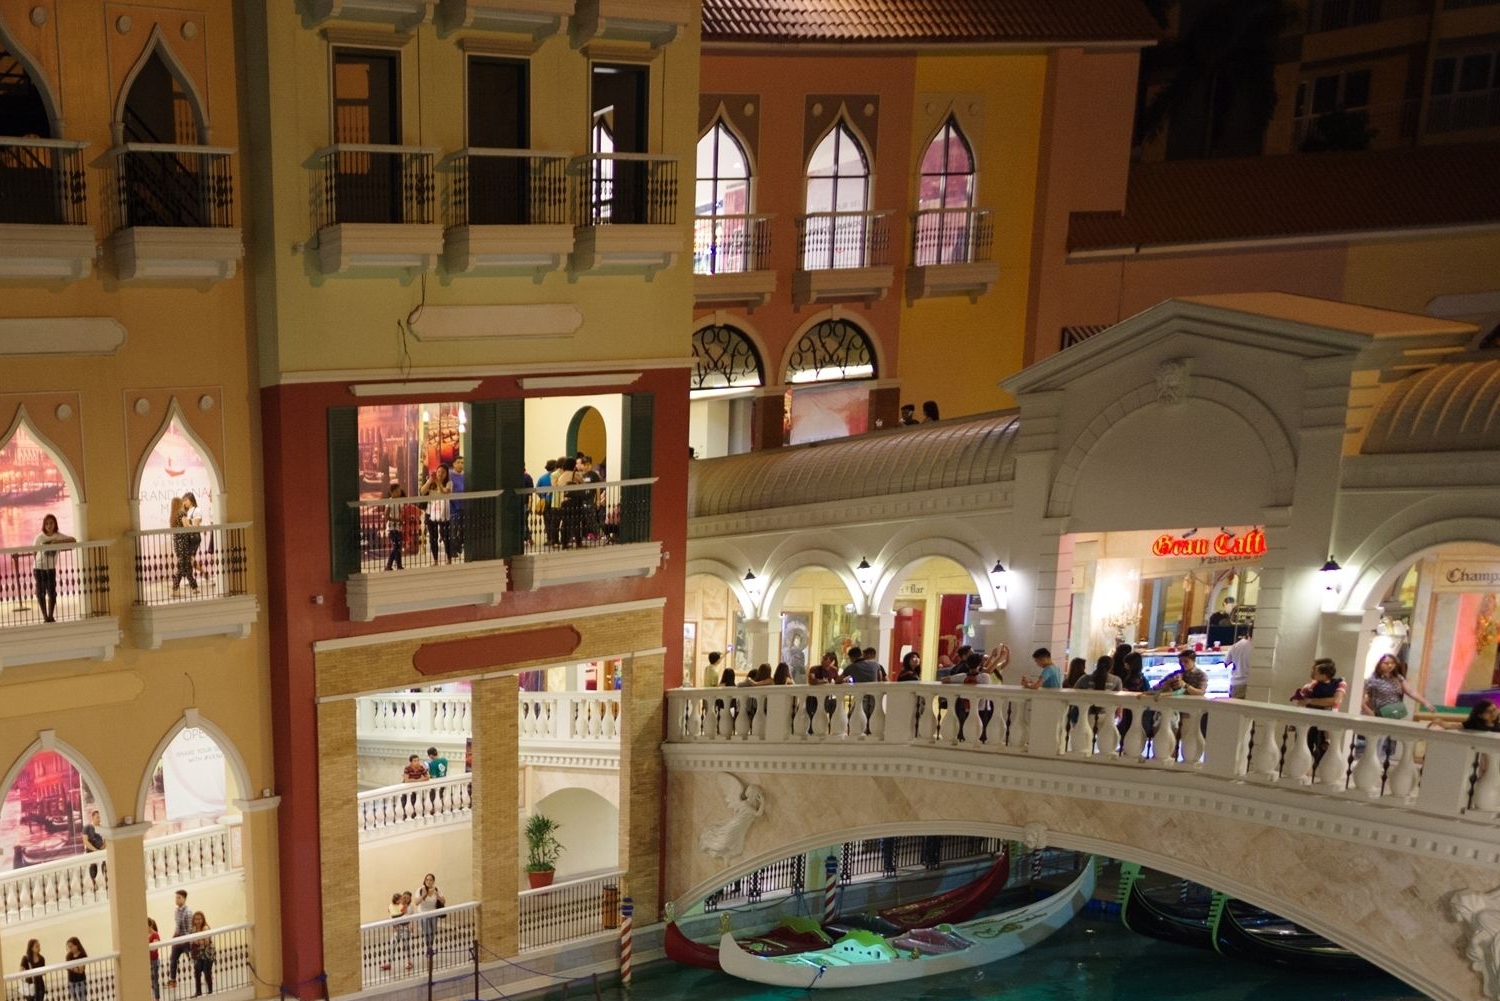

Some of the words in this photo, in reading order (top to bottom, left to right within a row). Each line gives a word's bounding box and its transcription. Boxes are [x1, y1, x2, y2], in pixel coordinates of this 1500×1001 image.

[1152, 533, 1209, 557] Gran
[1213, 527, 1268, 556] Caff
[910, 583, 925, 594] Bar
